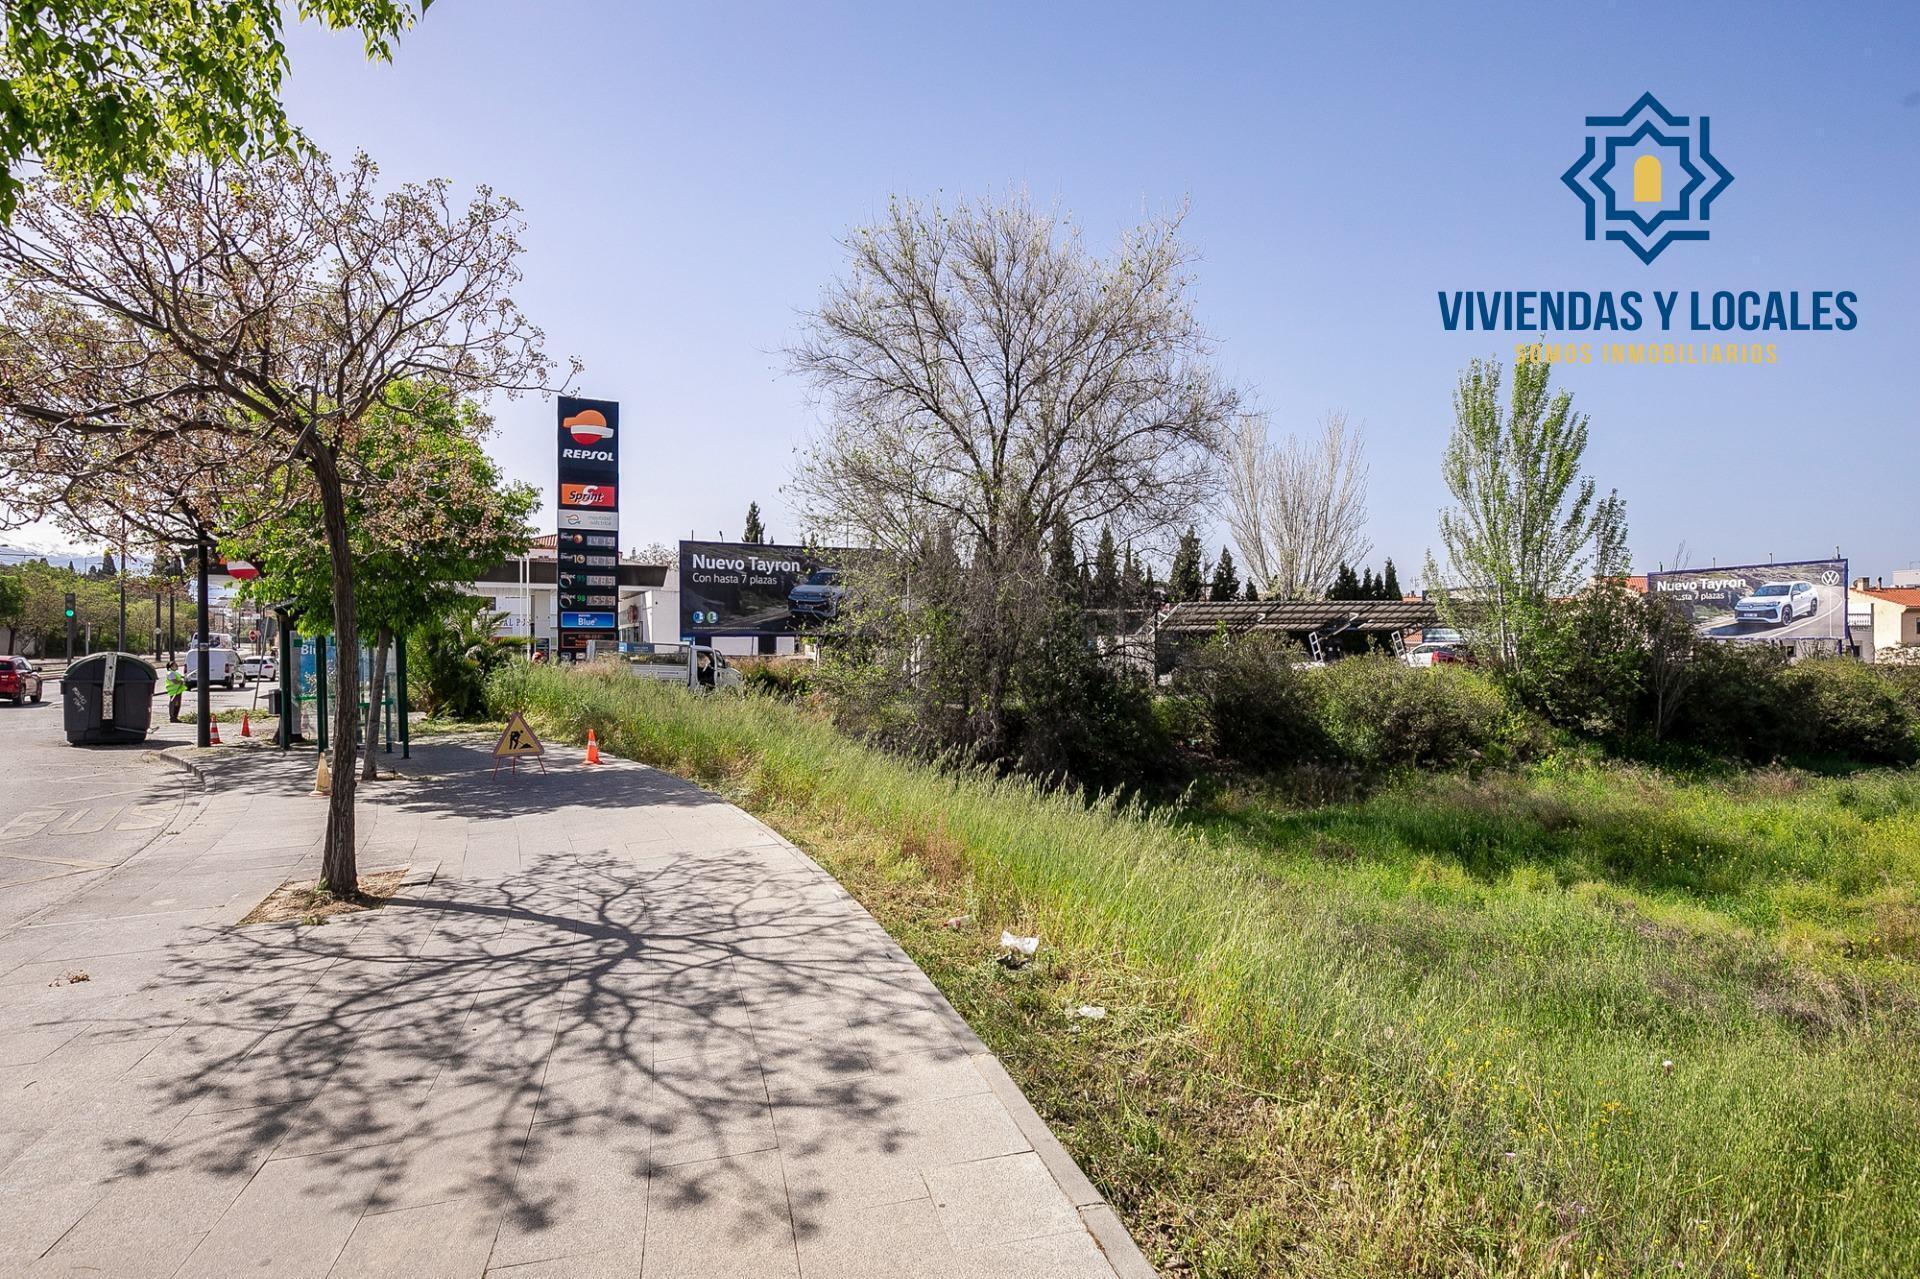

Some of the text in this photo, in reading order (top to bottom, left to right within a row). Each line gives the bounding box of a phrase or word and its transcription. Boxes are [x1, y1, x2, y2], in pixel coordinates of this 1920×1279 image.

[562, 448, 614, 461] REPSOL
[568, 489, 604, 504] Sprint
[692, 553, 801, 575] Nuevo Tayron
[692, 572, 777, 586] Con hasta 7 plazas
[1657, 578, 1746, 592] Nuevo Tayron
[1700, 592, 1725, 601] plazas
[578, 617, 595, 626] Blue
